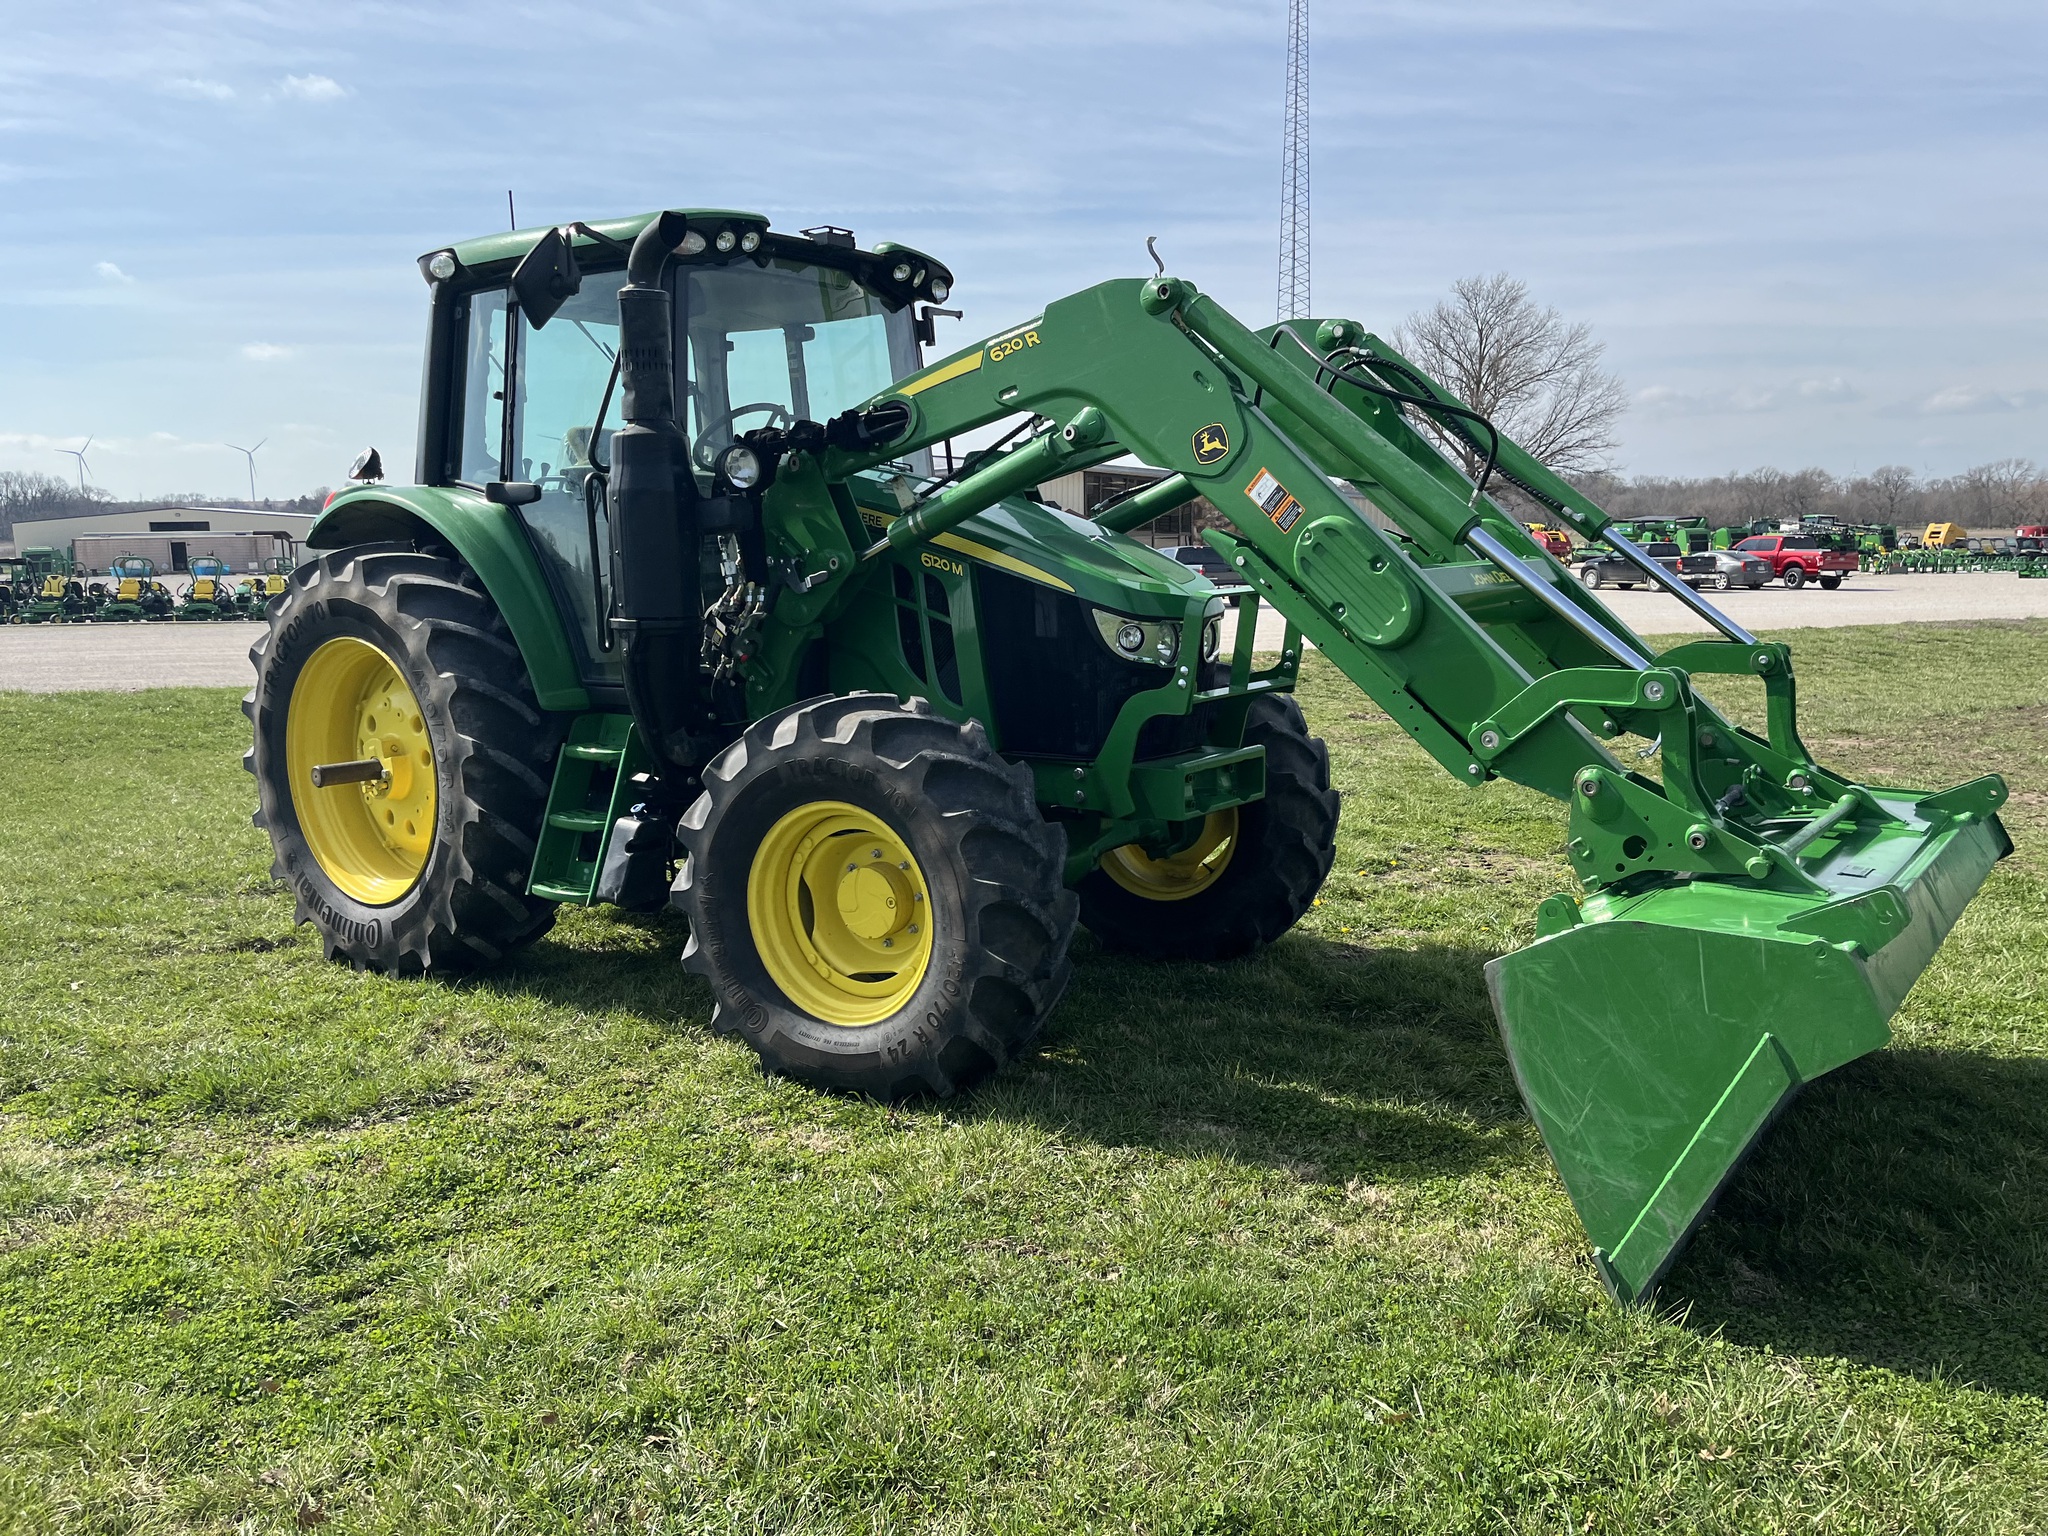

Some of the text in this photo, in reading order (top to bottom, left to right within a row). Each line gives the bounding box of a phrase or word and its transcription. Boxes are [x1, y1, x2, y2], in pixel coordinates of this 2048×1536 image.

[989, 330, 1042, 362] 620 R
[920, 552, 963, 577] 6120 M
[263, 600, 326, 697] TRACTOR 70
[294, 869, 383, 950] Continental
[886, 1038, 914, 1065] 24
